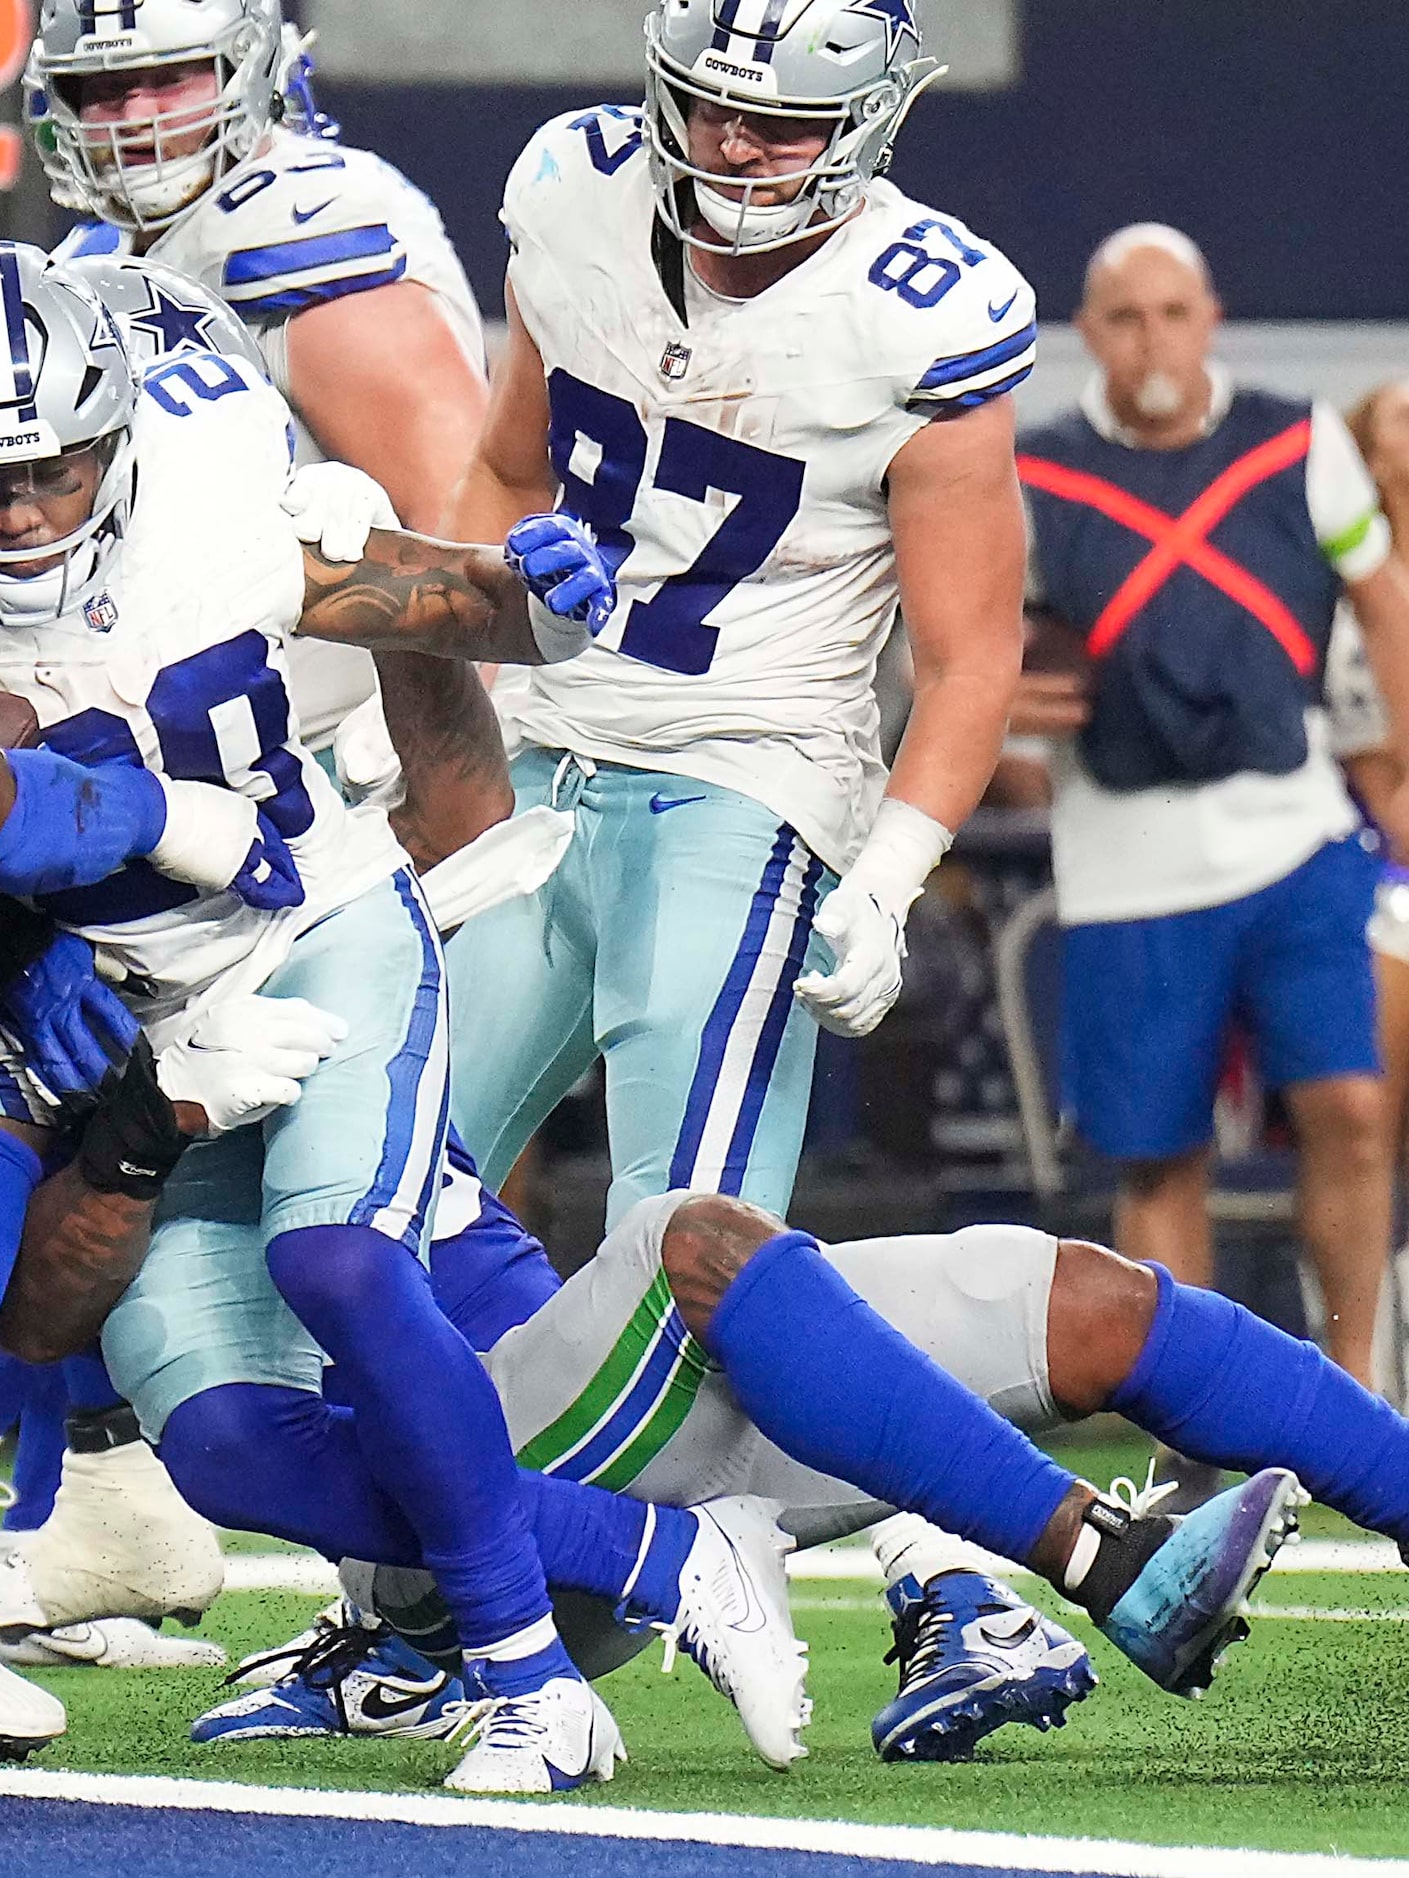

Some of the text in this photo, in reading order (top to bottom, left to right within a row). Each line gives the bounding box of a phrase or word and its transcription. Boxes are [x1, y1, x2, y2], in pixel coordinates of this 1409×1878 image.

[705, 57, 764, 83] COWBOYS
[867, 218, 987, 309] 87
[548, 366, 807, 676] 87
[88, 605, 114, 627] NFL
